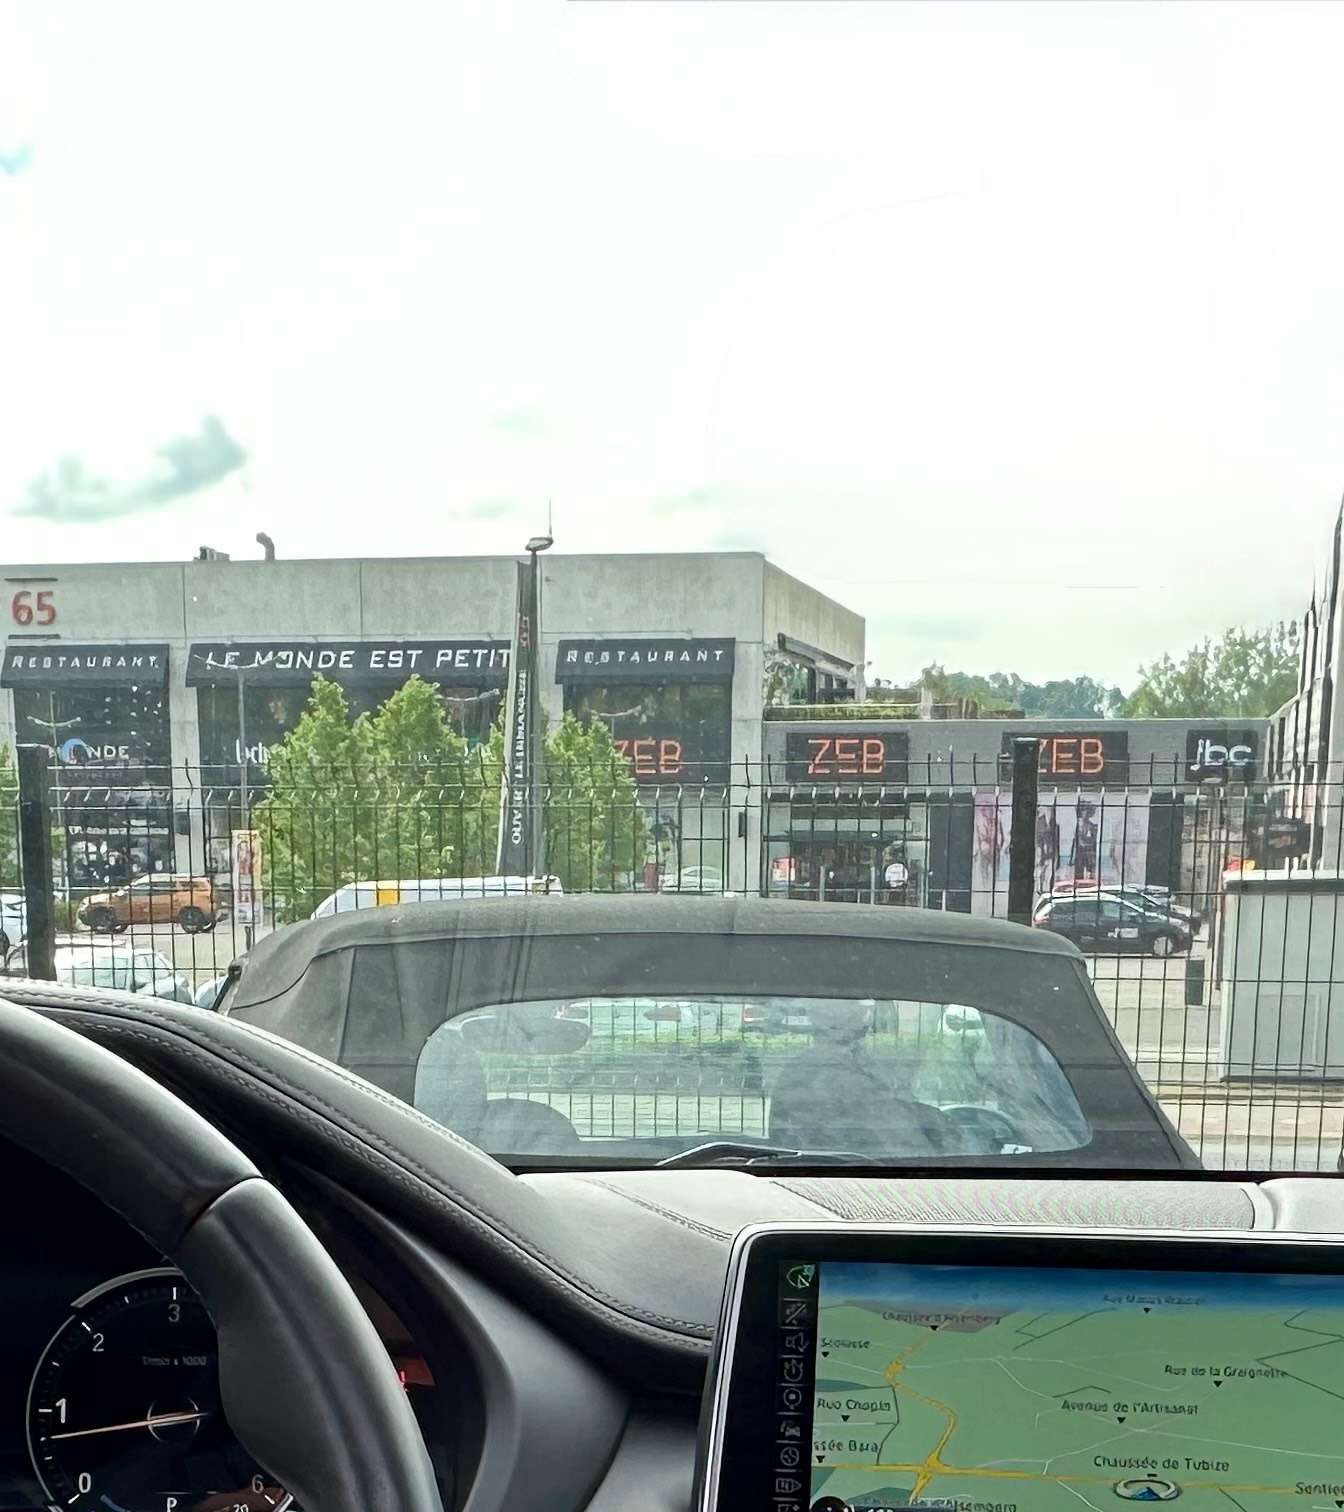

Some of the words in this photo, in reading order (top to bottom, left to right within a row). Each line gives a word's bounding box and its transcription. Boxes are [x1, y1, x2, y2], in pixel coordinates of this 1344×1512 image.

[11, 590, 58, 626] 65
[11, 654, 160, 670] RESTAURANT
[206, 651, 240, 670] LE
[255, 649, 356, 669] MONDE
[369, 649, 424, 669] EST
[436, 648, 512, 669] PETIT
[566, 649, 724, 666] RESTAURANT
[807, 738, 886, 775] ZEB
[168, 1304, 181, 1323] 3
[92, 1333, 105, 1353] 2
[55, 1398, 68, 1425] 1
[1093, 1454, 1157, 1470] Chaussée
[1162, 1456, 1180, 1470] de
[1184, 1457, 1230, 1472] Tubize
[78, 1473, 92, 1493] 0
[251, 1474, 264, 1494] 6
